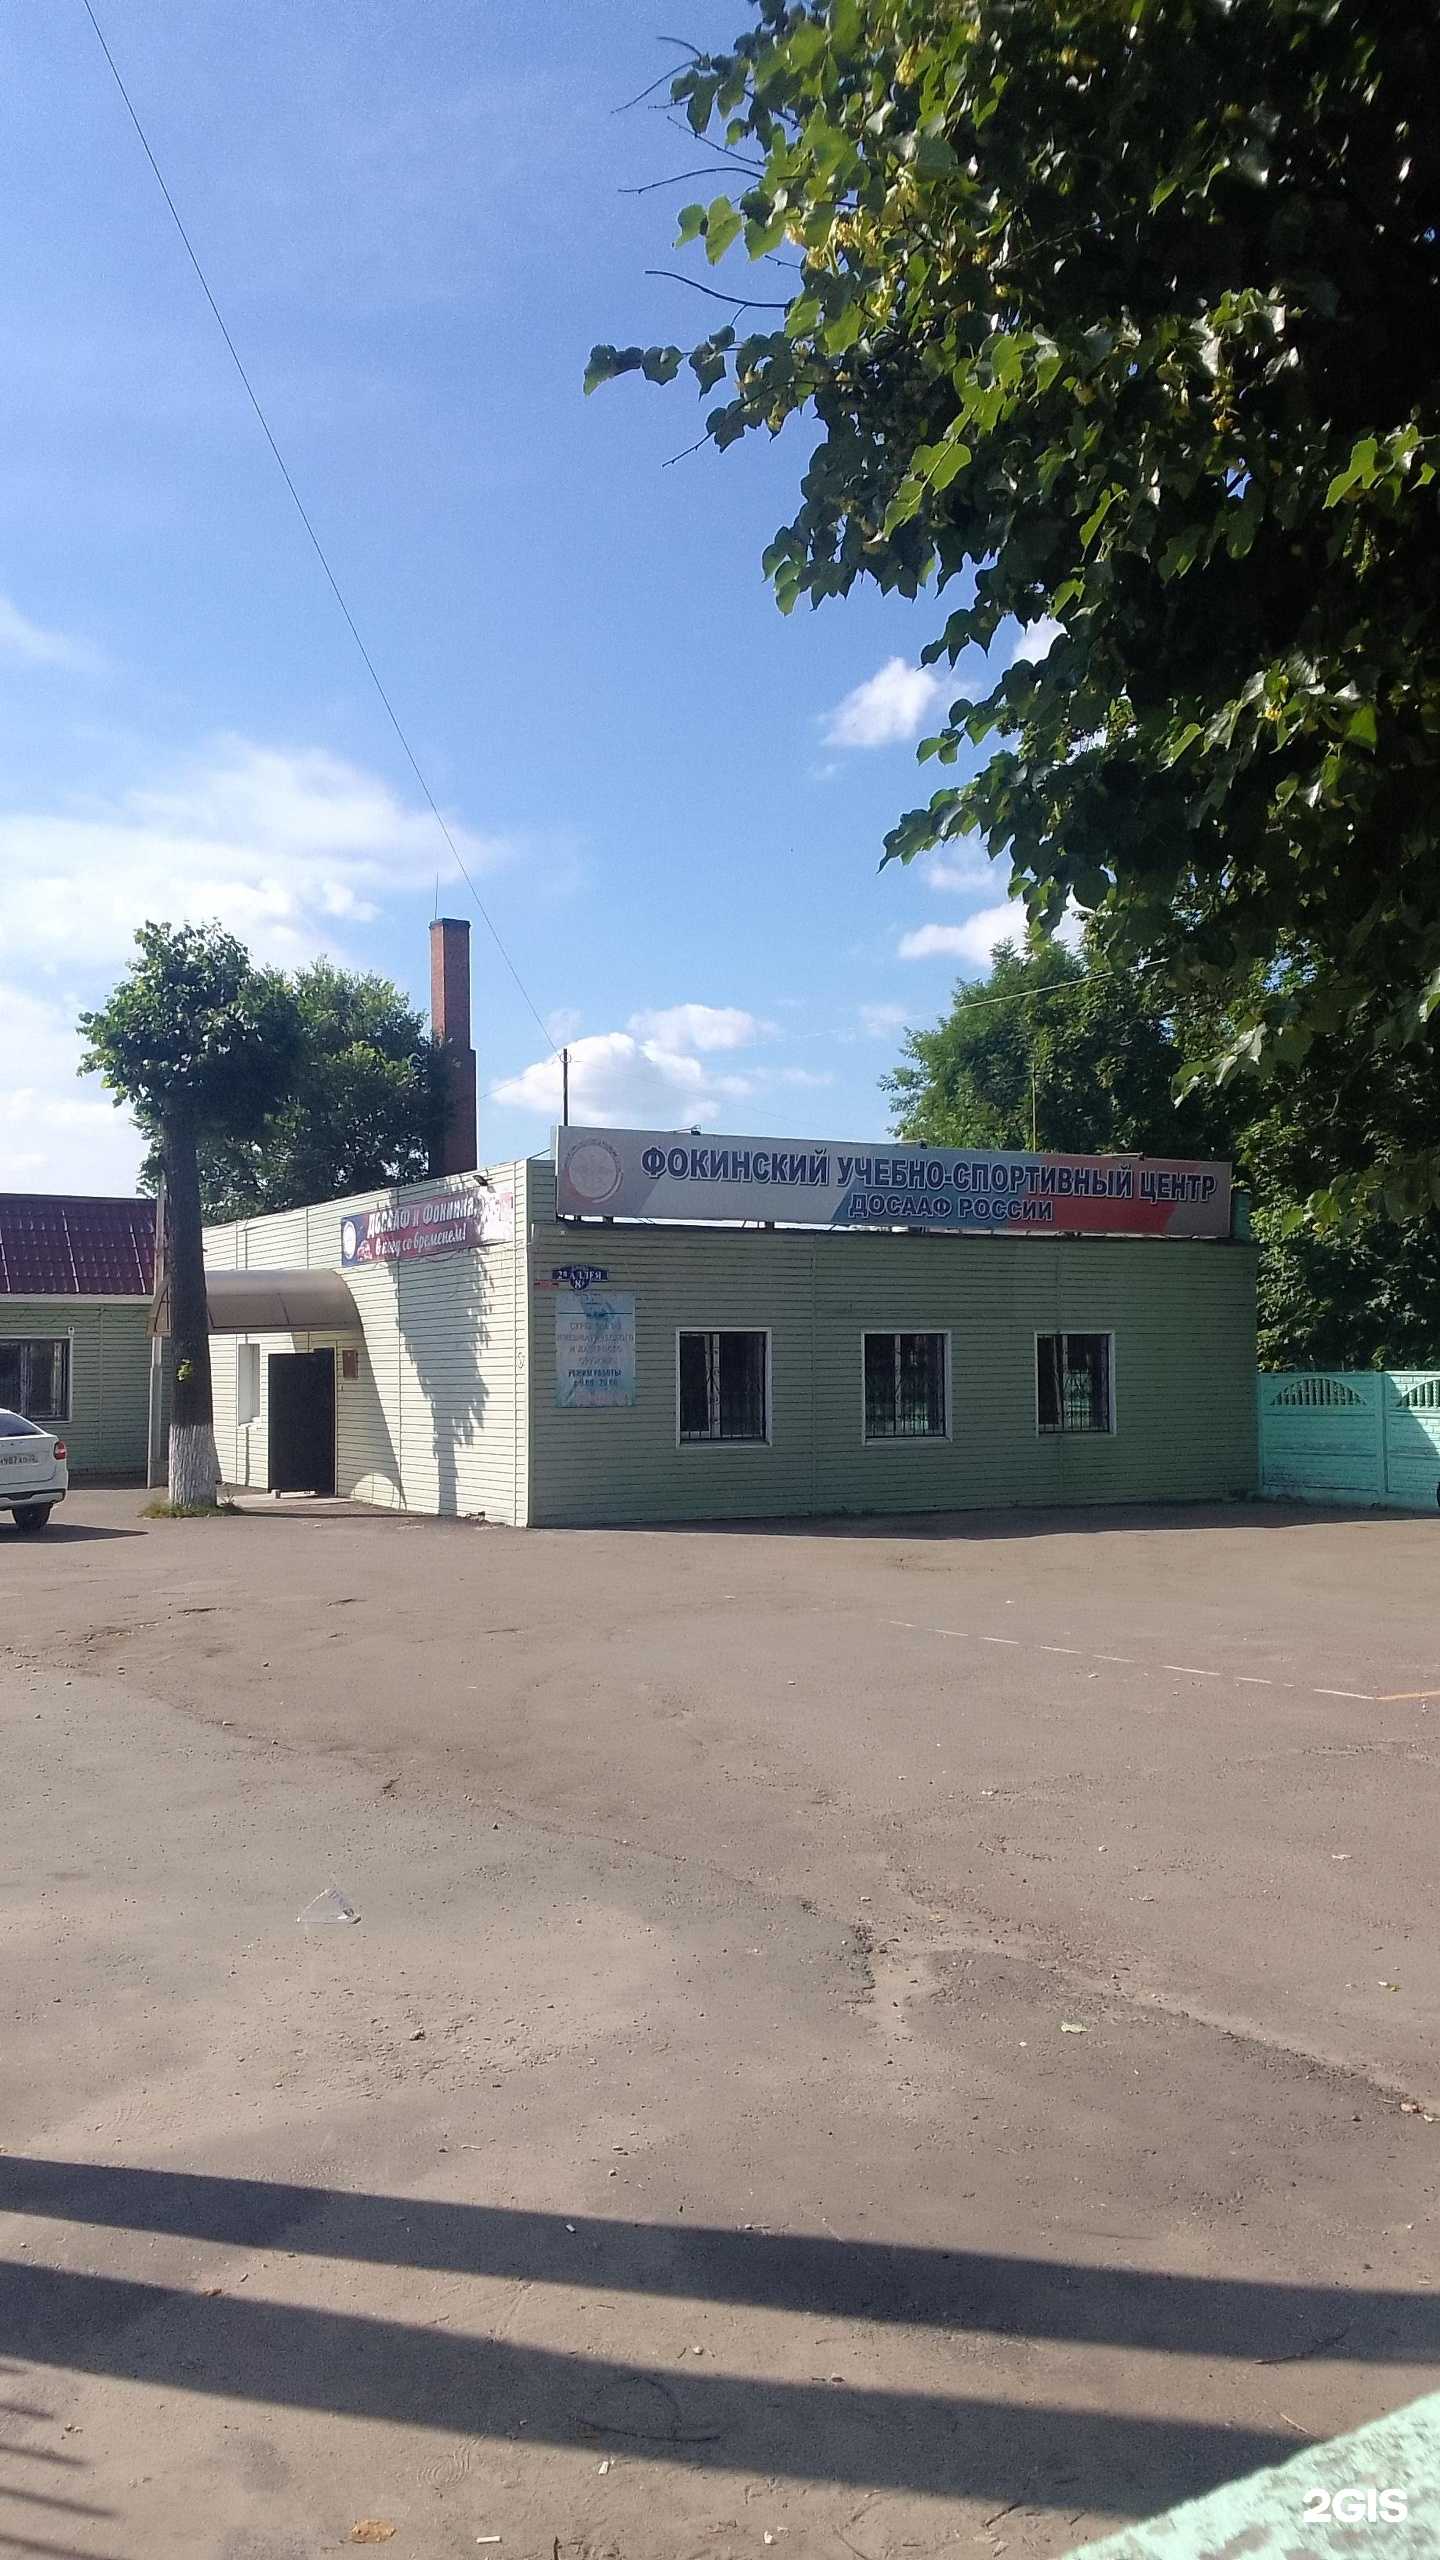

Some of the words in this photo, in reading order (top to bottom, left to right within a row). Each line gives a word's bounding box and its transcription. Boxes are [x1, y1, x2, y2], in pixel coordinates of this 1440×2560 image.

[641, 1146, 830, 1186] ФОКИНСКИЙ
[837, 1154, 1133, 1199] УЧЕБНО-СПОРТИВНЫЙ
[1139, 1172, 1217, 1204] ЦЕНТР
[367, 1206, 410, 1239] ДОСААФ
[849, 1192, 952, 1219] ДОСААФ
[958, 1198, 1053, 1221] РОССИИ
